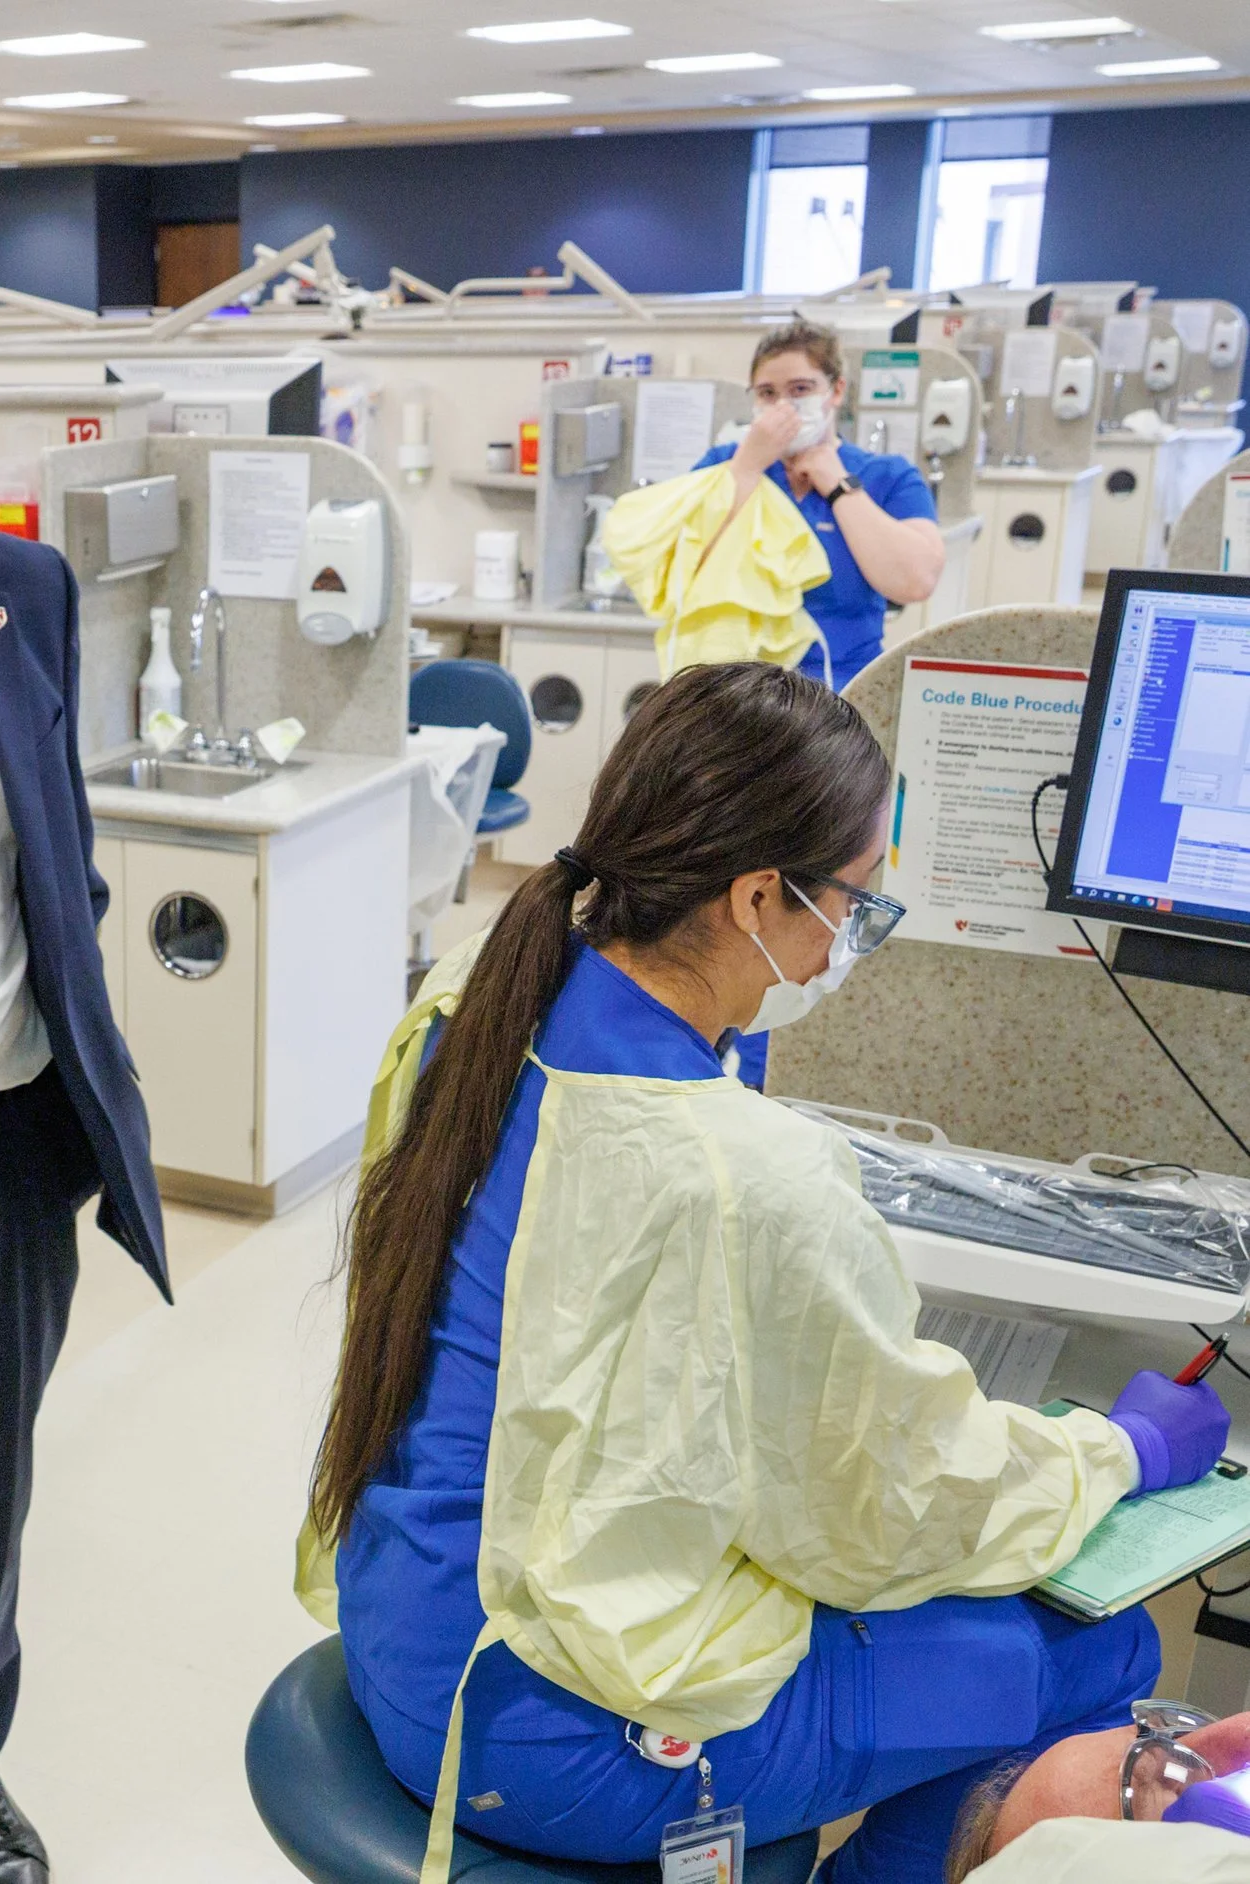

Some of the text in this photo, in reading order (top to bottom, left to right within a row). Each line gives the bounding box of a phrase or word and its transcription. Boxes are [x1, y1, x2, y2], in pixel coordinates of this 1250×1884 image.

[69, 423, 99, 444] 12
[922, 688, 965, 705] Code
[971, 692, 1008, 709] Blue
